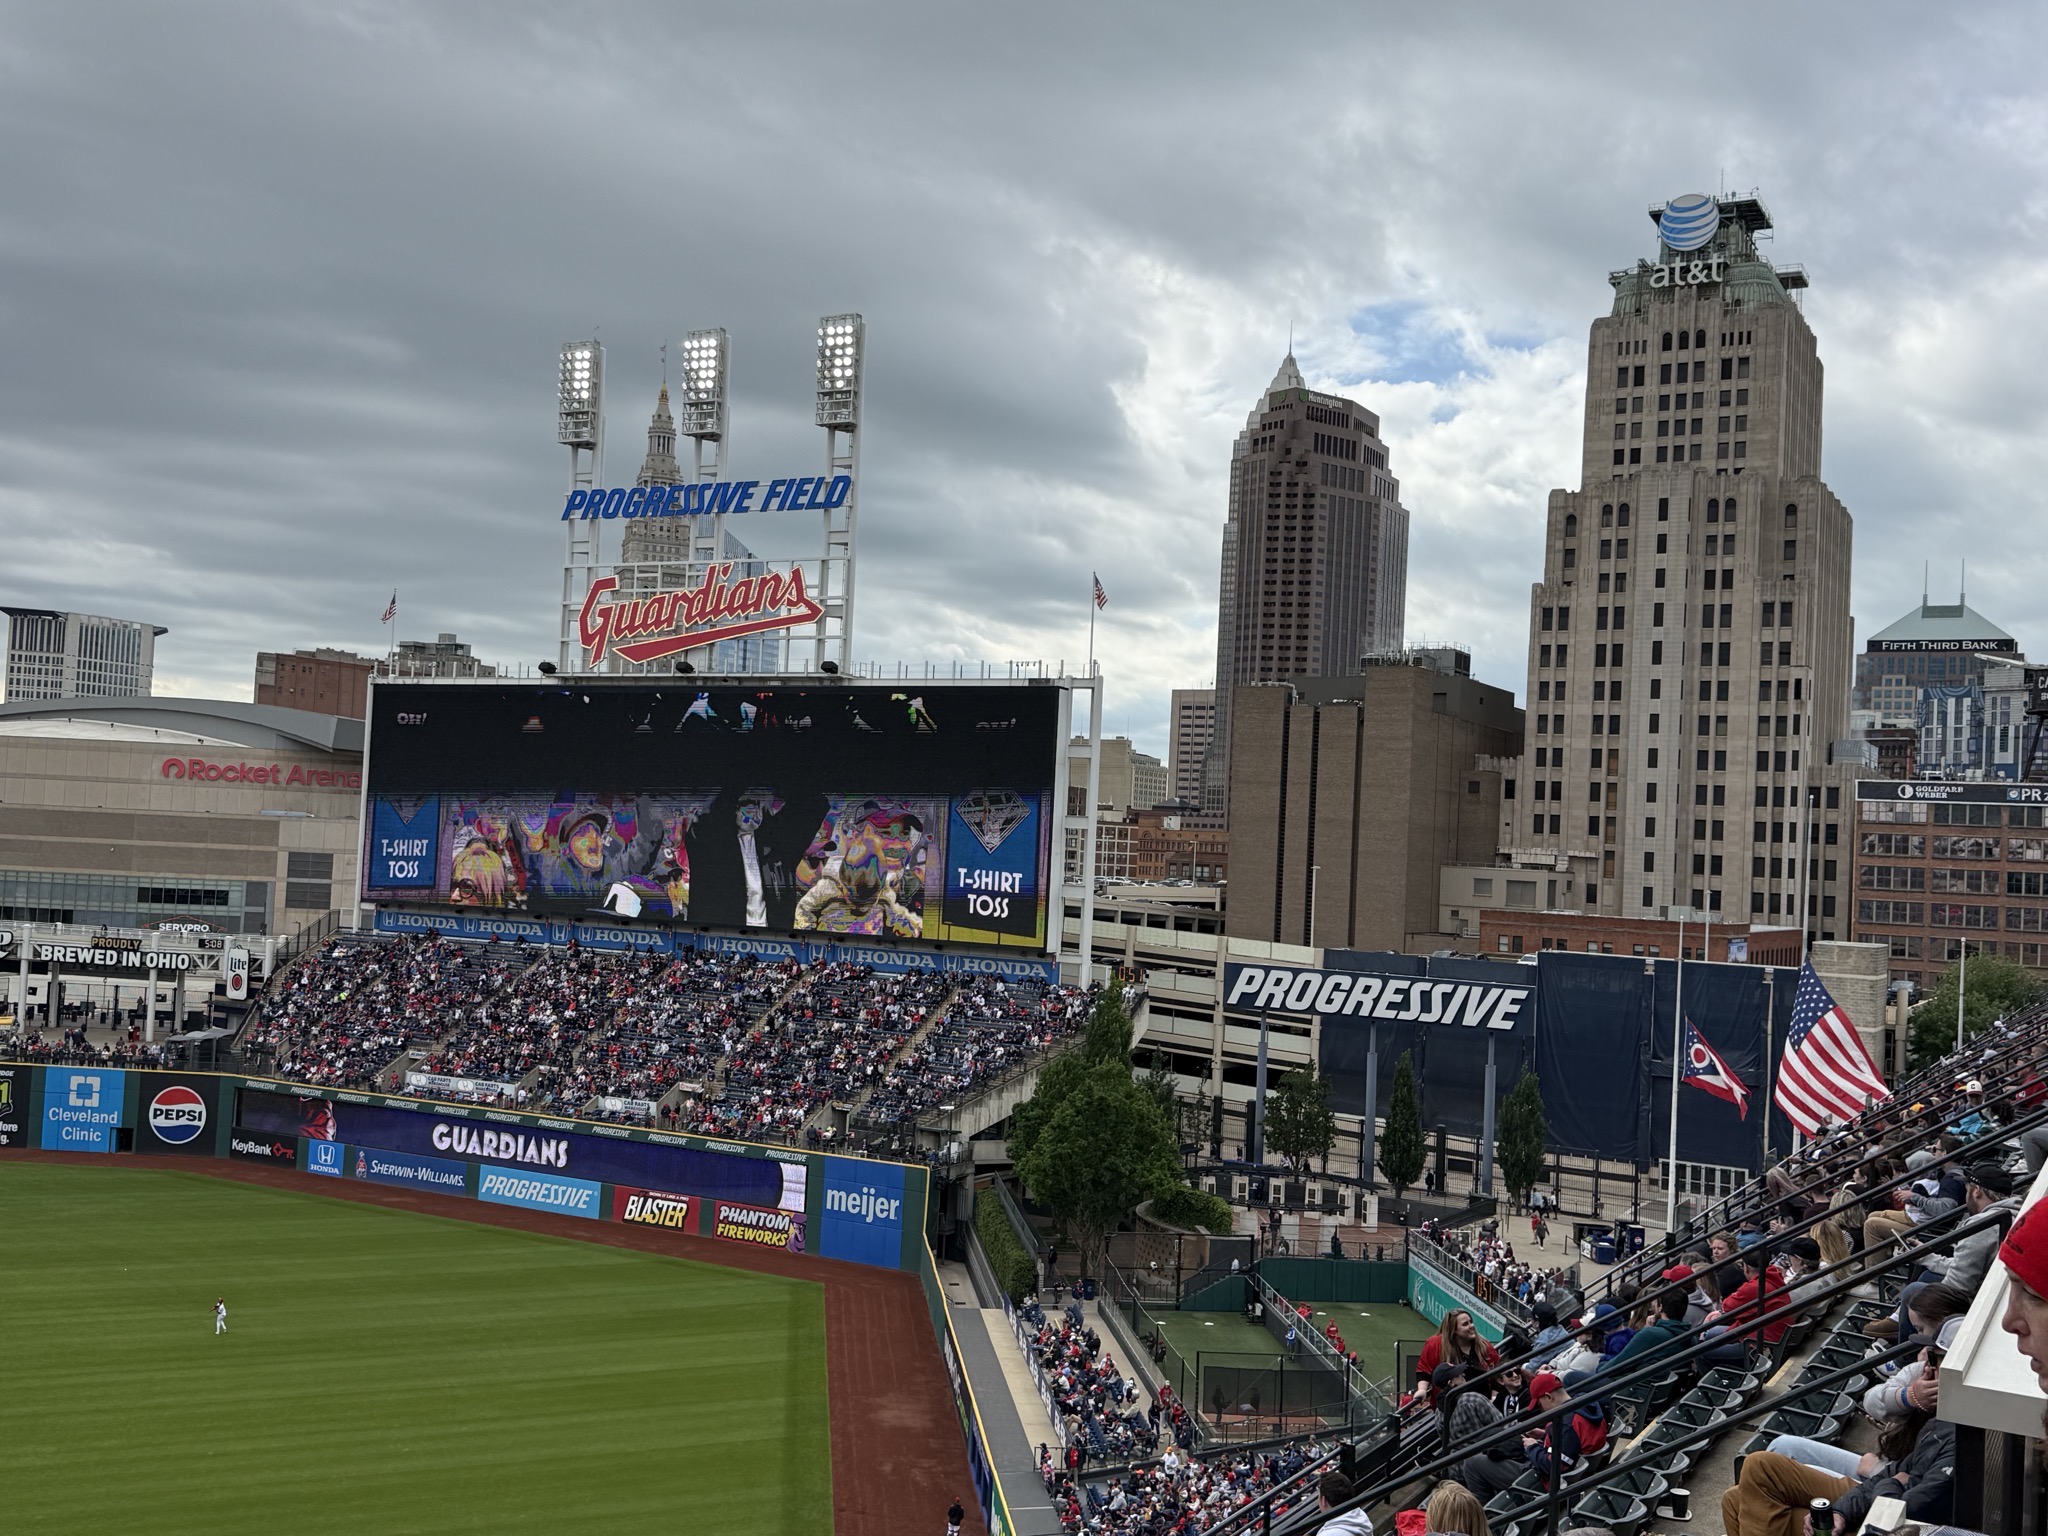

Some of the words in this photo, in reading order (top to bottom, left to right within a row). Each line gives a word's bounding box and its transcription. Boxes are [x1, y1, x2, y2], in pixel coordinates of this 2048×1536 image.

[1650, 253, 1725, 288] at&t
[561, 481, 759, 521] PROGRESSIVE
[759, 475, 851, 513] FIELD
[578, 561, 825, 669] Guardians
[1882, 641, 1916, 650] FIFTH
[1919, 641, 1960, 650] THIRD
[1962, 641, 1998, 650] BANK
[397, 712, 428, 725] OH!
[187, 758, 281, 785] Rocket
[286, 764, 361, 789] Arena
[1916, 791, 1948, 799] WEBER
[381, 838, 429, 857] T-SHIRT
[388, 860, 419, 878] TOSS
[958, 867, 1022, 894] T-SHIRT
[967, 895, 1009, 919] TOSS
[158, 923, 210, 932] SERVPRO
[91, 936, 141, 949] PROUDLY
[204, 939, 222, 948] 5:08
[397, 914, 460, 930] HONDA
[478, 919, 544, 936] HONDA
[594, 929, 665, 946] HONDA
[721, 938, 796, 957] HONDA
[856, 949, 936, 969] HONDA
[962, 958, 1049, 978] HONDA
[40, 945, 119, 966] BREWED
[122, 951, 141, 967] IN
[145, 952, 190, 970] OHIO
[229, 956, 247, 973] Lite
[1226, 967, 1529, 1030] PROGRESSIVE
[49, 1108, 118, 1124] Cleveland
[152, 1108, 202, 1122] PEPSI
[246, 1080, 277, 1091] PROGRESSIVE
[290, 1086, 323, 1097] PROGRESSIVE
[336, 1093, 369, 1103] PROGRESSIVE
[384, 1099, 419, 1110] PROGRESSIVE
[434, 1105, 469, 1117] PROGRESSIVE
[485, 1111, 521, 1123] PROGRESSIVE
[537, 1118, 575, 1130] PROGRESSIVE
[591, 1126, 630, 1138] PROGRESSIVE
[647, 1133, 687, 1146] PROGRESSIVE
[705, 1141, 746, 1154] PROGRESSIVE
[765, 1149, 807, 1162] PROGRESSIVE
[62, 1126, 102, 1142] Clinic
[432, 1123, 568, 1168] GUARDIANS
[232, 1138, 272, 1156] KeyBank
[310, 1164, 340, 1175] HONDA
[481, 1174, 592, 1209] PROGRESSIVE
[624, 1195, 687, 1227] BLASTER
[826, 1186, 900, 1223] meijer
[719, 1205, 790, 1230] PHANTOM
[716, 1223, 788, 1247] FIREWORKS
